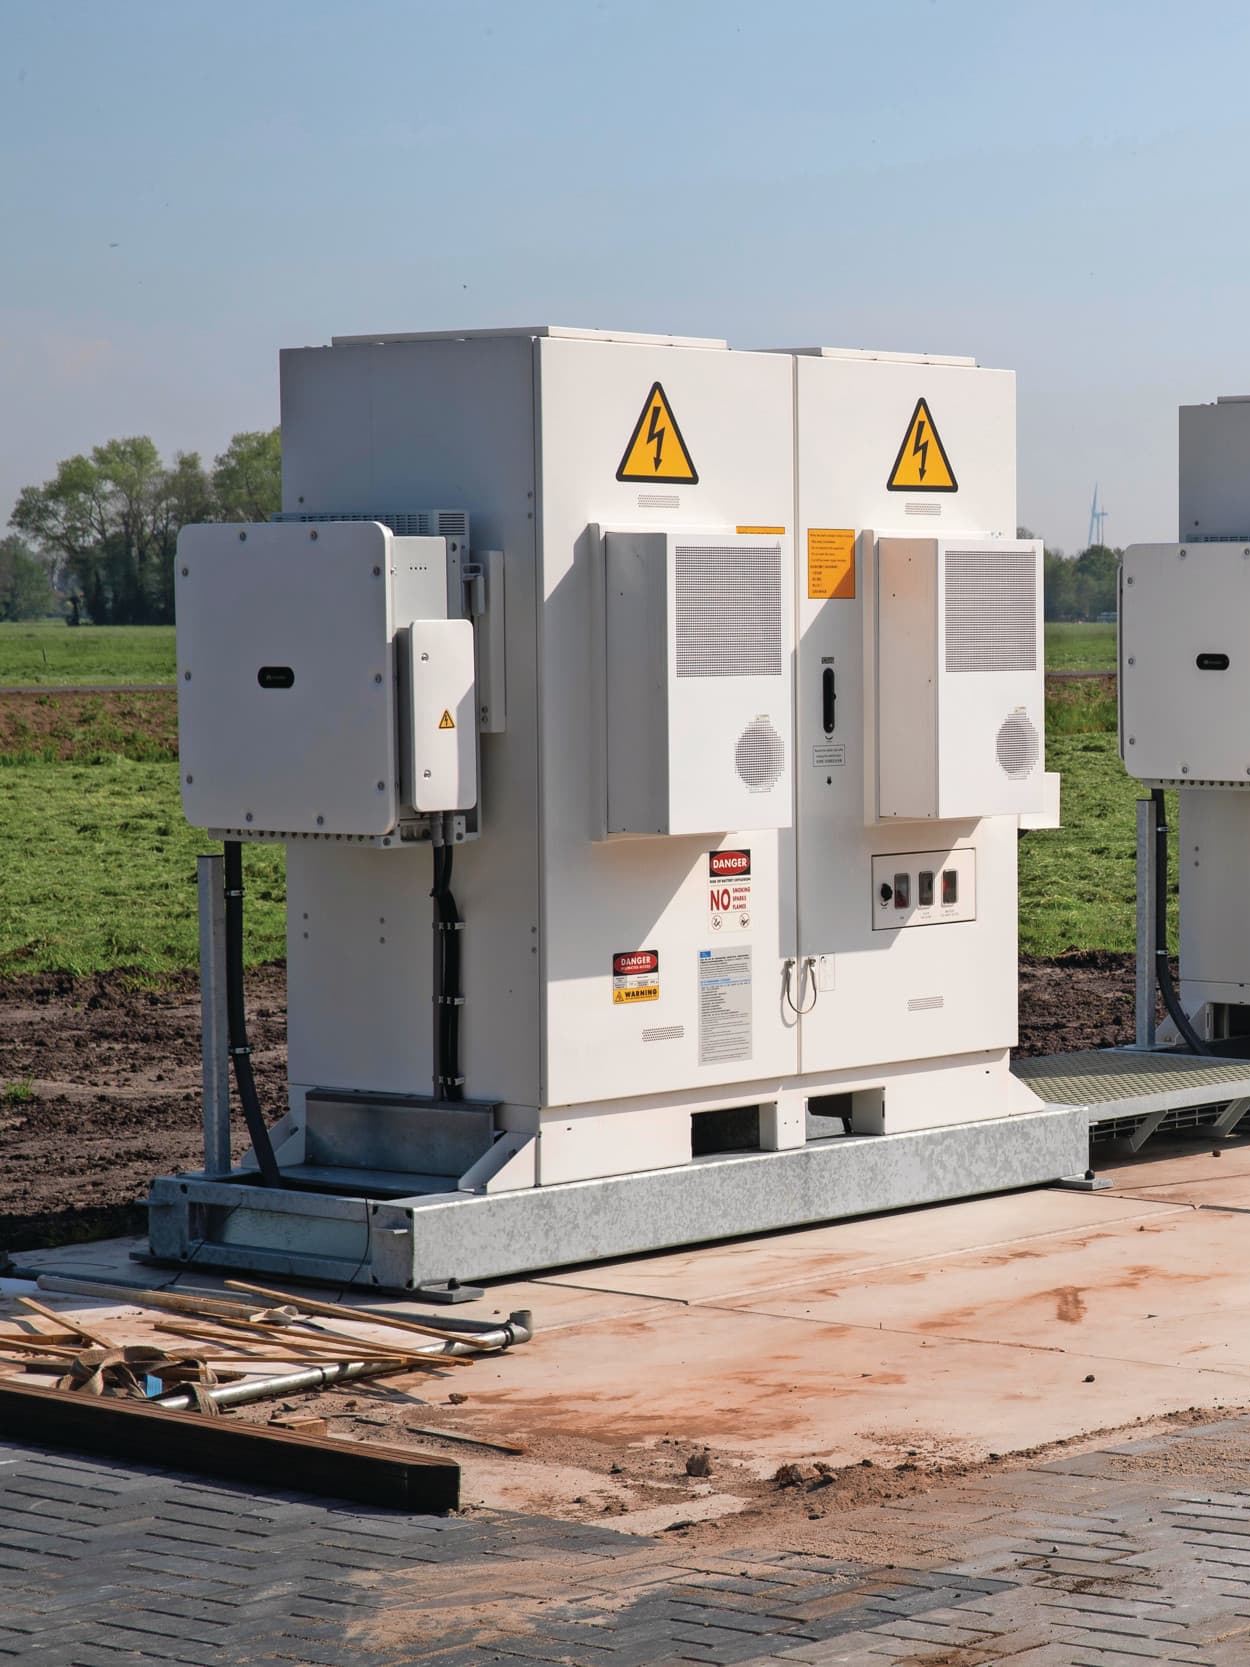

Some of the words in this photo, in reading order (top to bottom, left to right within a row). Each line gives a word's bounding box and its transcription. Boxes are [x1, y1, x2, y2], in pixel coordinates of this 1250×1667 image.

[713, 857, 747, 869] DANGER
[710, 888, 731, 911] NO
[621, 956, 651, 966] DANGER
[624, 988, 657, 998] WARNING
